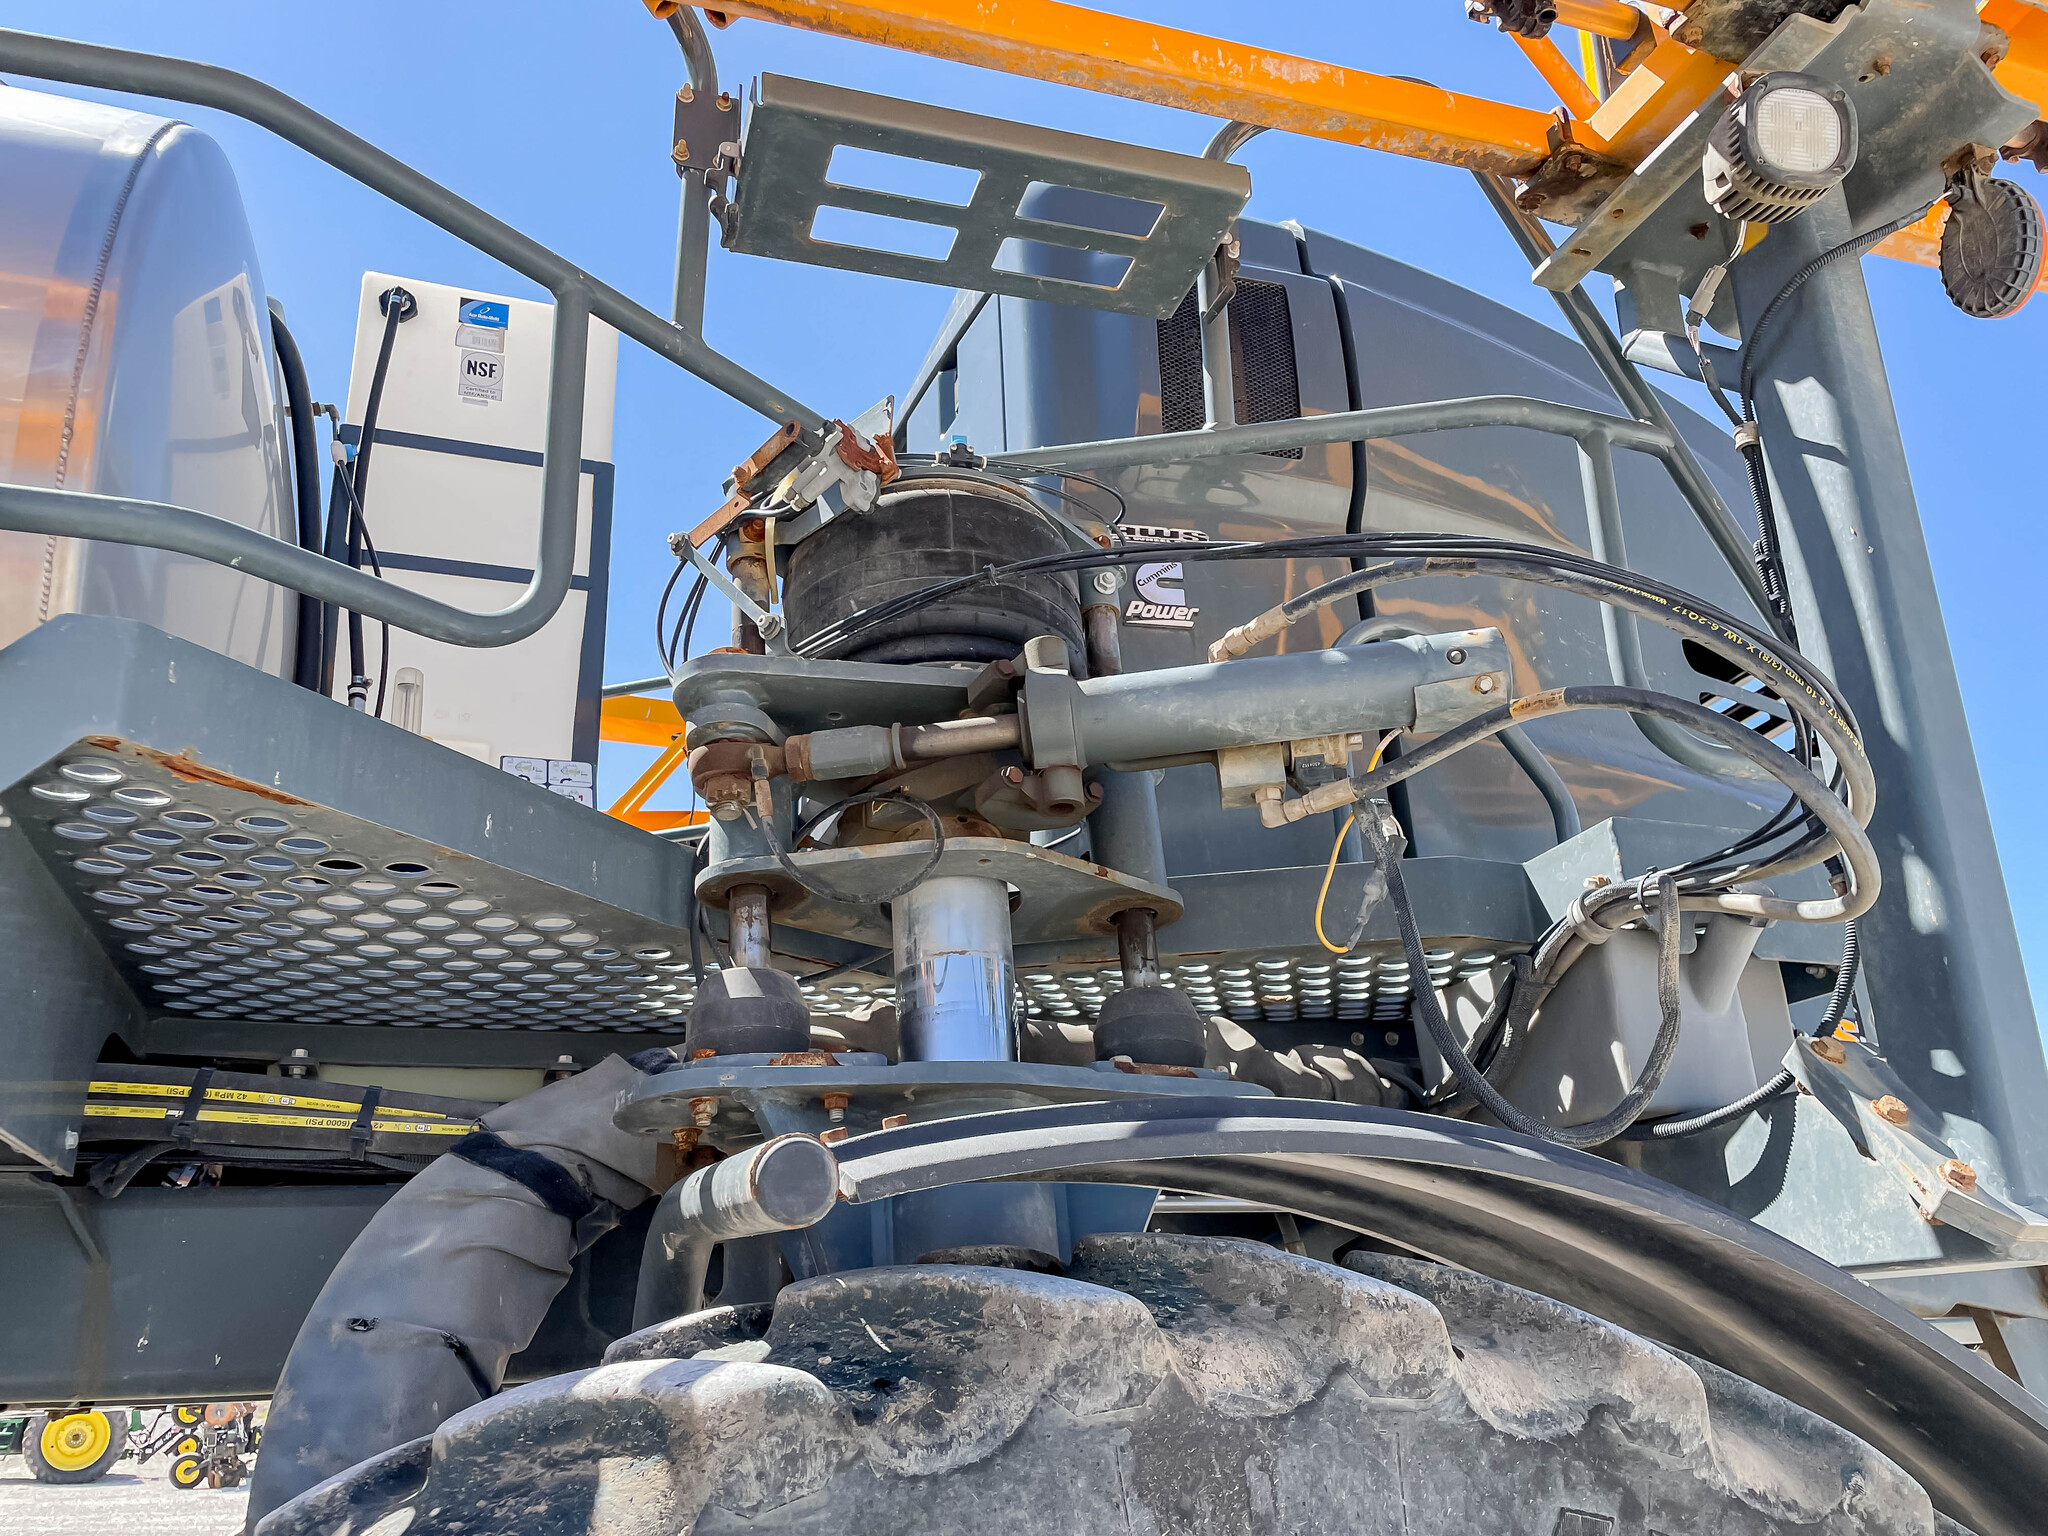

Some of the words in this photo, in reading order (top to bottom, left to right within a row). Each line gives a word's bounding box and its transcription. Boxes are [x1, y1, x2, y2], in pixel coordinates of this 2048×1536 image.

[467, 359, 498, 378] NSF
[1137, 562, 1178, 587] Cummins
[1125, 600, 1200, 620] Power
[1723, 630, 1743, 645] 1W
[1758, 651, 1783, 671] (3/8)
[1785, 668, 1805, 687] mm
[1806, 685, 1817, 698] 10
[166, 1086, 185, 1096] PSI)
[214, 1091, 235, 1100] MPa
[236, 1092, 248, 1100] 42
[305, 1117, 324, 1127] PSI)
[326, 1119, 351, 1128] (6000
